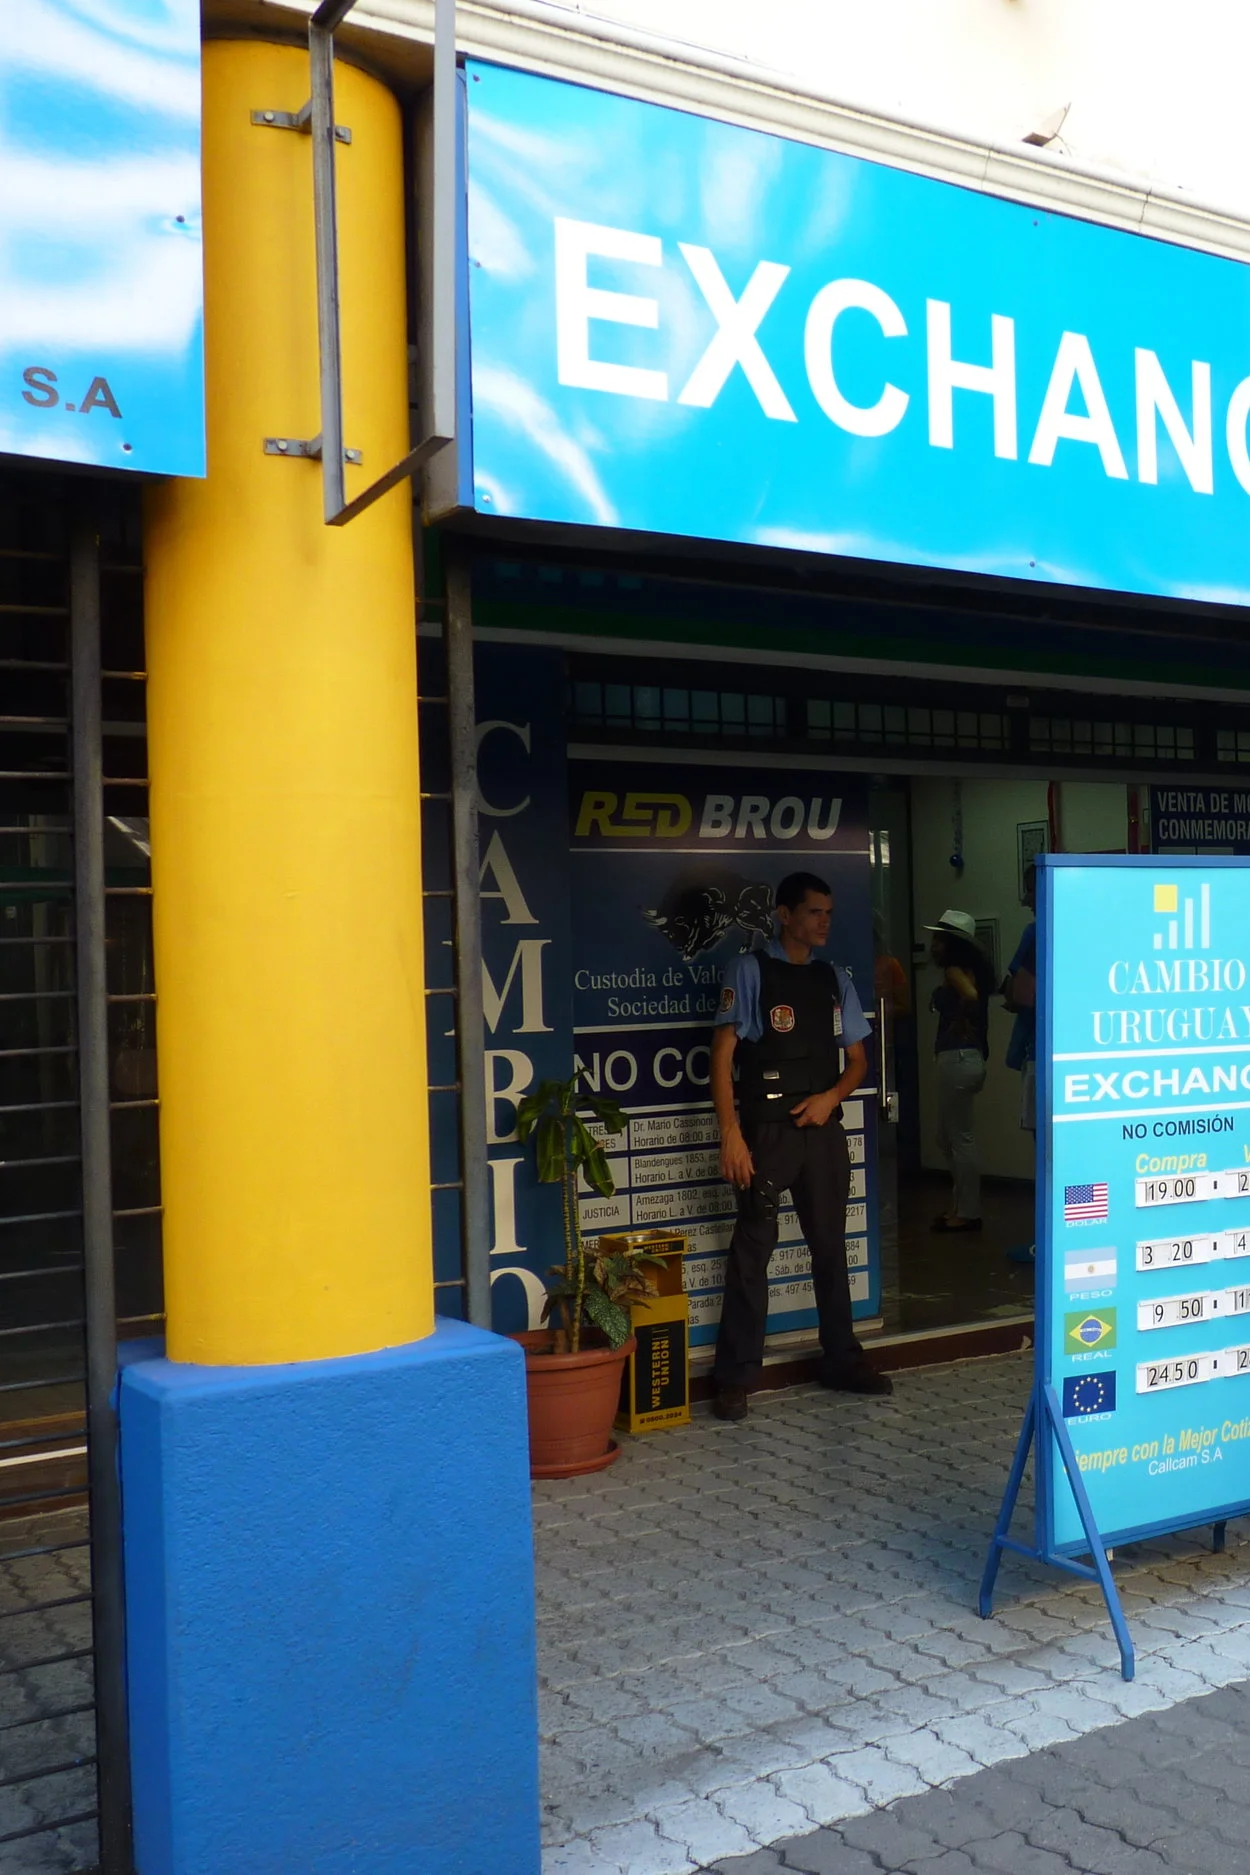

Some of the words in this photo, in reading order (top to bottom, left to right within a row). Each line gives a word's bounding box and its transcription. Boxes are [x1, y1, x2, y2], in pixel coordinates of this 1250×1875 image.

[21, 366, 123, 419] S.A
[1157, 791, 1205, 813] VENTA
[1210, 793, 1229, 814] DE
[574, 967, 657, 991] Custodia
[662, 965, 684, 987] de
[1108, 958, 1246, 994] CAMBIO
[607, 993, 690, 1017] Sociedad
[696, 993, 716, 1012] de
[573, 1050, 638, 1093] NO
[653, 1045, 714, 1087] CO
[633, 1120, 645, 1132] Dr.
[648, 1118, 672, 1131] Mario
[673, 1117, 713, 1129] Cassinoni
[1122, 1123, 1147, 1140] NO
[1152, 1113, 1234, 1138] COMISIÓN
[634, 1135, 665, 1148] Horario
[667, 1134, 677, 1145] de
[679, 1131, 703, 1143] 08:00
[705, 1133, 711, 1141] a
[634, 1154, 683, 1169] Blandengues
[1135, 1152, 1208, 1174] Compra
[635, 1170, 666, 1184] Horario
[695, 1166, 706, 1177] de
[583, 1206, 620, 1220] JUSTICIA
[635, 1193, 674, 1206] Amezaga
[636, 1208, 667, 1221] Horario
[696, 1203, 707, 1214] de
[708, 1200, 733, 1213] 08:00
[709, 1258, 722, 1270] 25
[779, 1250, 793, 1261] 917
[699, 1275, 709, 1286] de
[1069, 1289, 1113, 1301] PESO
[660, 1339, 670, 1386] UNION
[1071, 1351, 1112, 1363] REAL
[651, 1341, 661, 1408] WESTERN
[1067, 1413, 1112, 1426] EURO
[1065, 1446, 1128, 1474] iempre
[1131, 1441, 1158, 1462] con
[1162, 1434, 1174, 1454] la
[1178, 1428, 1217, 1456] Mejor
[1148, 1456, 1198, 1476] Callcam
[1201, 1447, 1223, 1464] S.A
